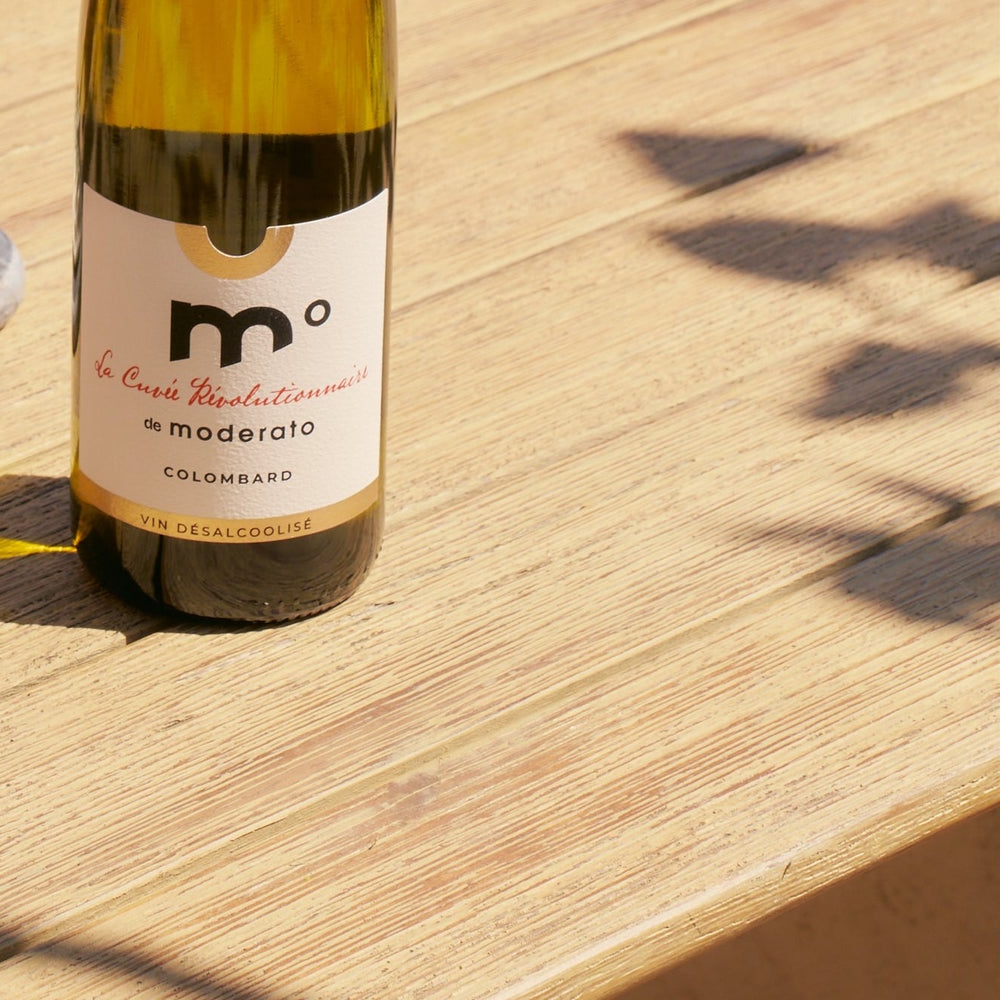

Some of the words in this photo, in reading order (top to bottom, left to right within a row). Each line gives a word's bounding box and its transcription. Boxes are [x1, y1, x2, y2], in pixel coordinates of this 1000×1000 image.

[94, 349, 115, 379] La
[122, 368, 180, 401] Cuvée
[188, 364, 368, 408] Révolutionnaire
[143, 416, 161, 432] de
[169, 420, 315, 443] moderato
[163, 466, 293, 485] COLOMBARD
[140, 514, 168, 531] VIN
[177, 514, 312, 538] DÉSALCOOLISÉ
